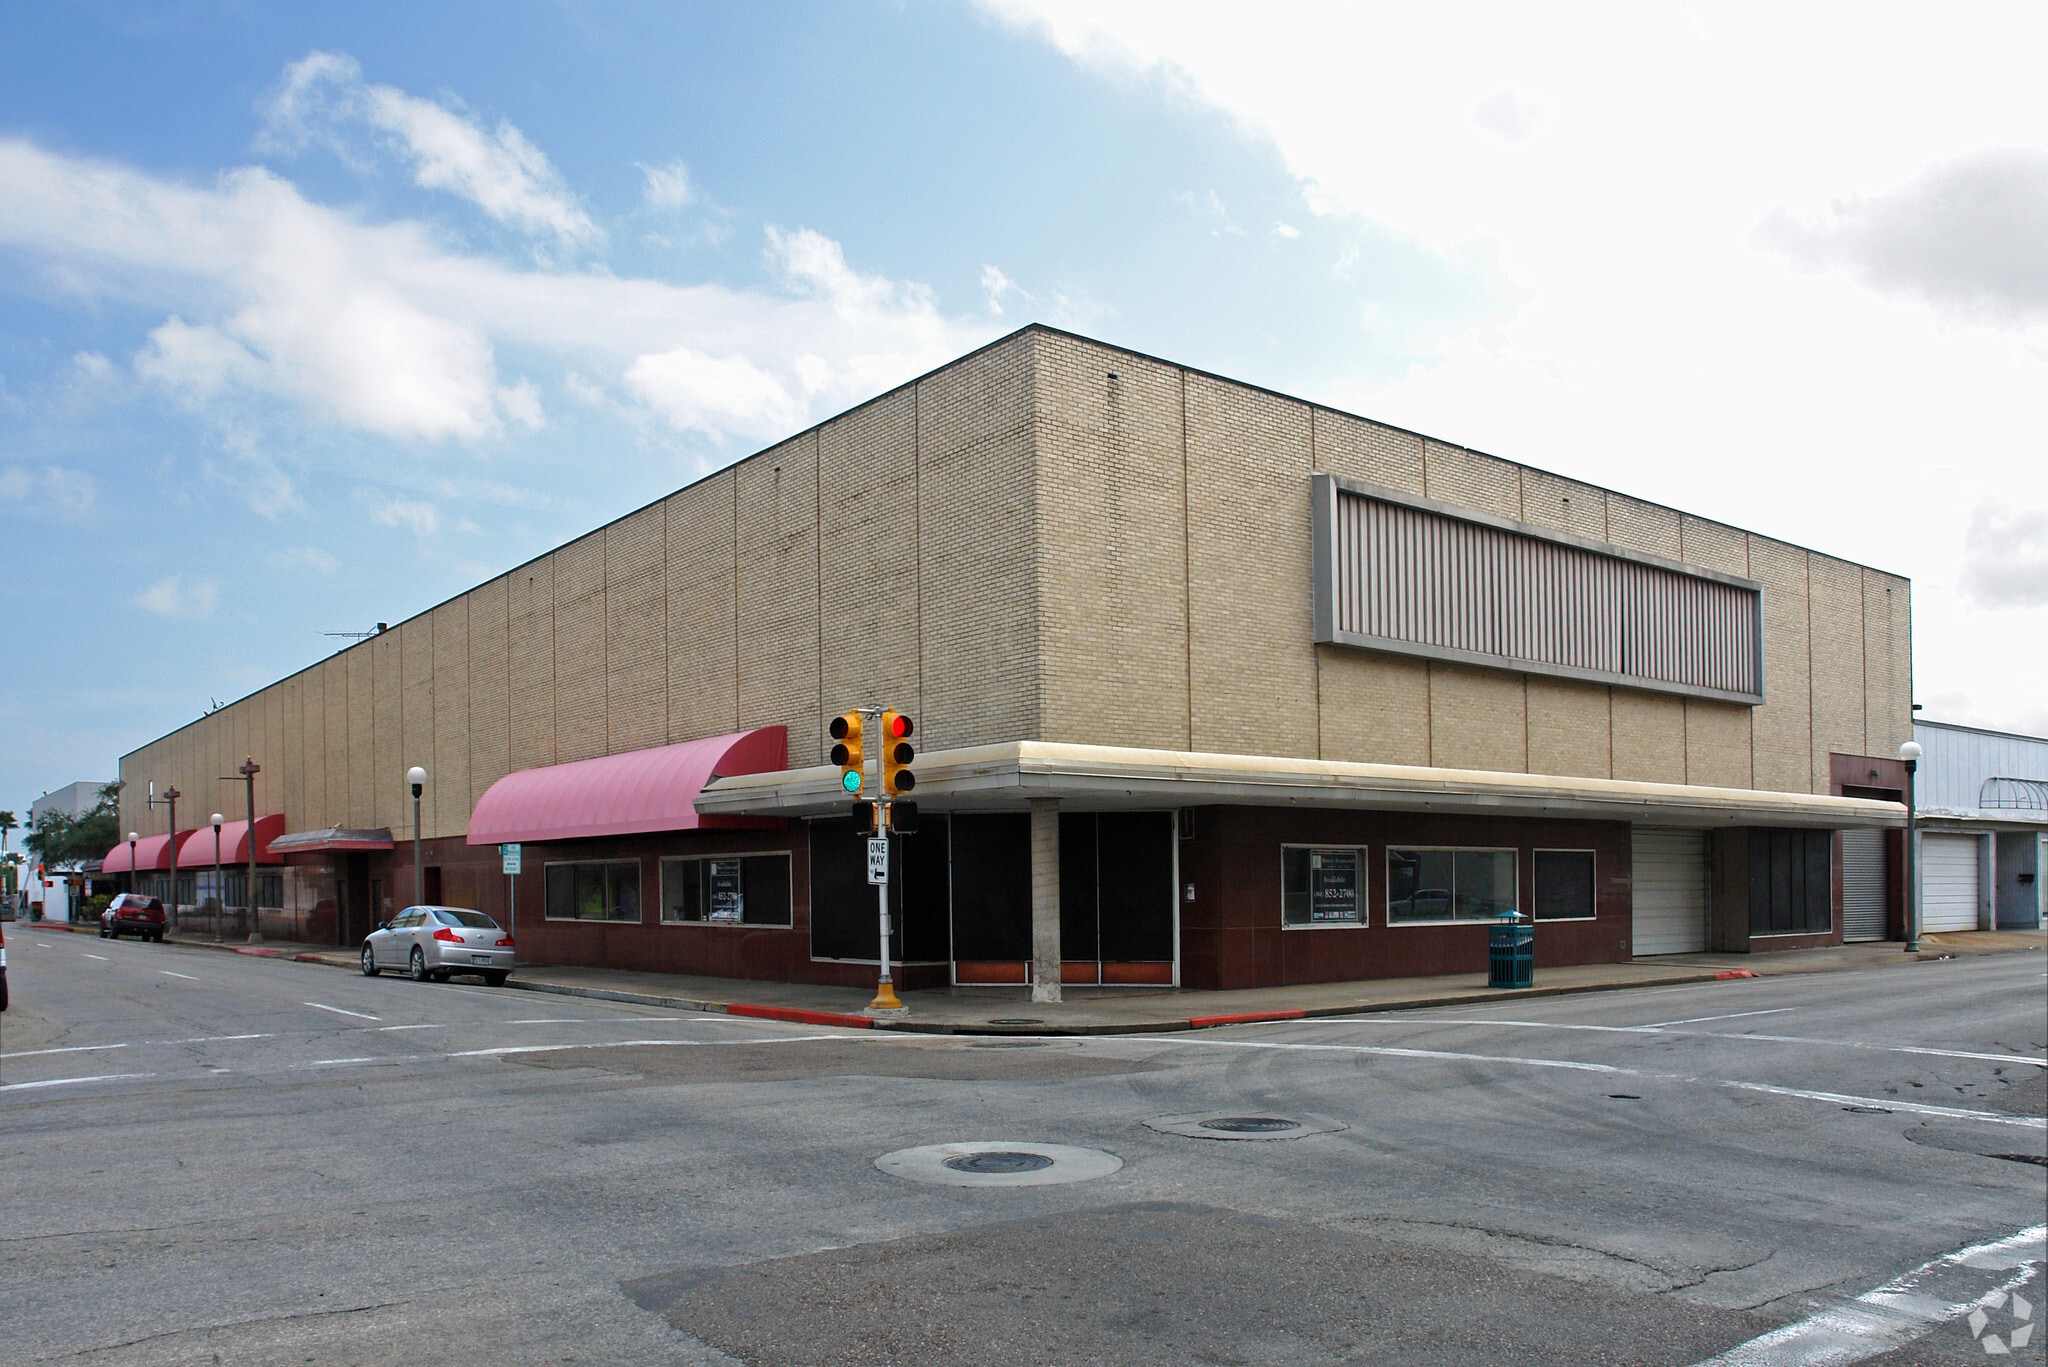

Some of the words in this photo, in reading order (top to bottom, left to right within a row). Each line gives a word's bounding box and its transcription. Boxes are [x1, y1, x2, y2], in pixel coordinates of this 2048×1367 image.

[870, 842, 885, 853] ONE
[870, 855, 885, 865] WAY
[1324, 888, 1354, 898] 852-2700
